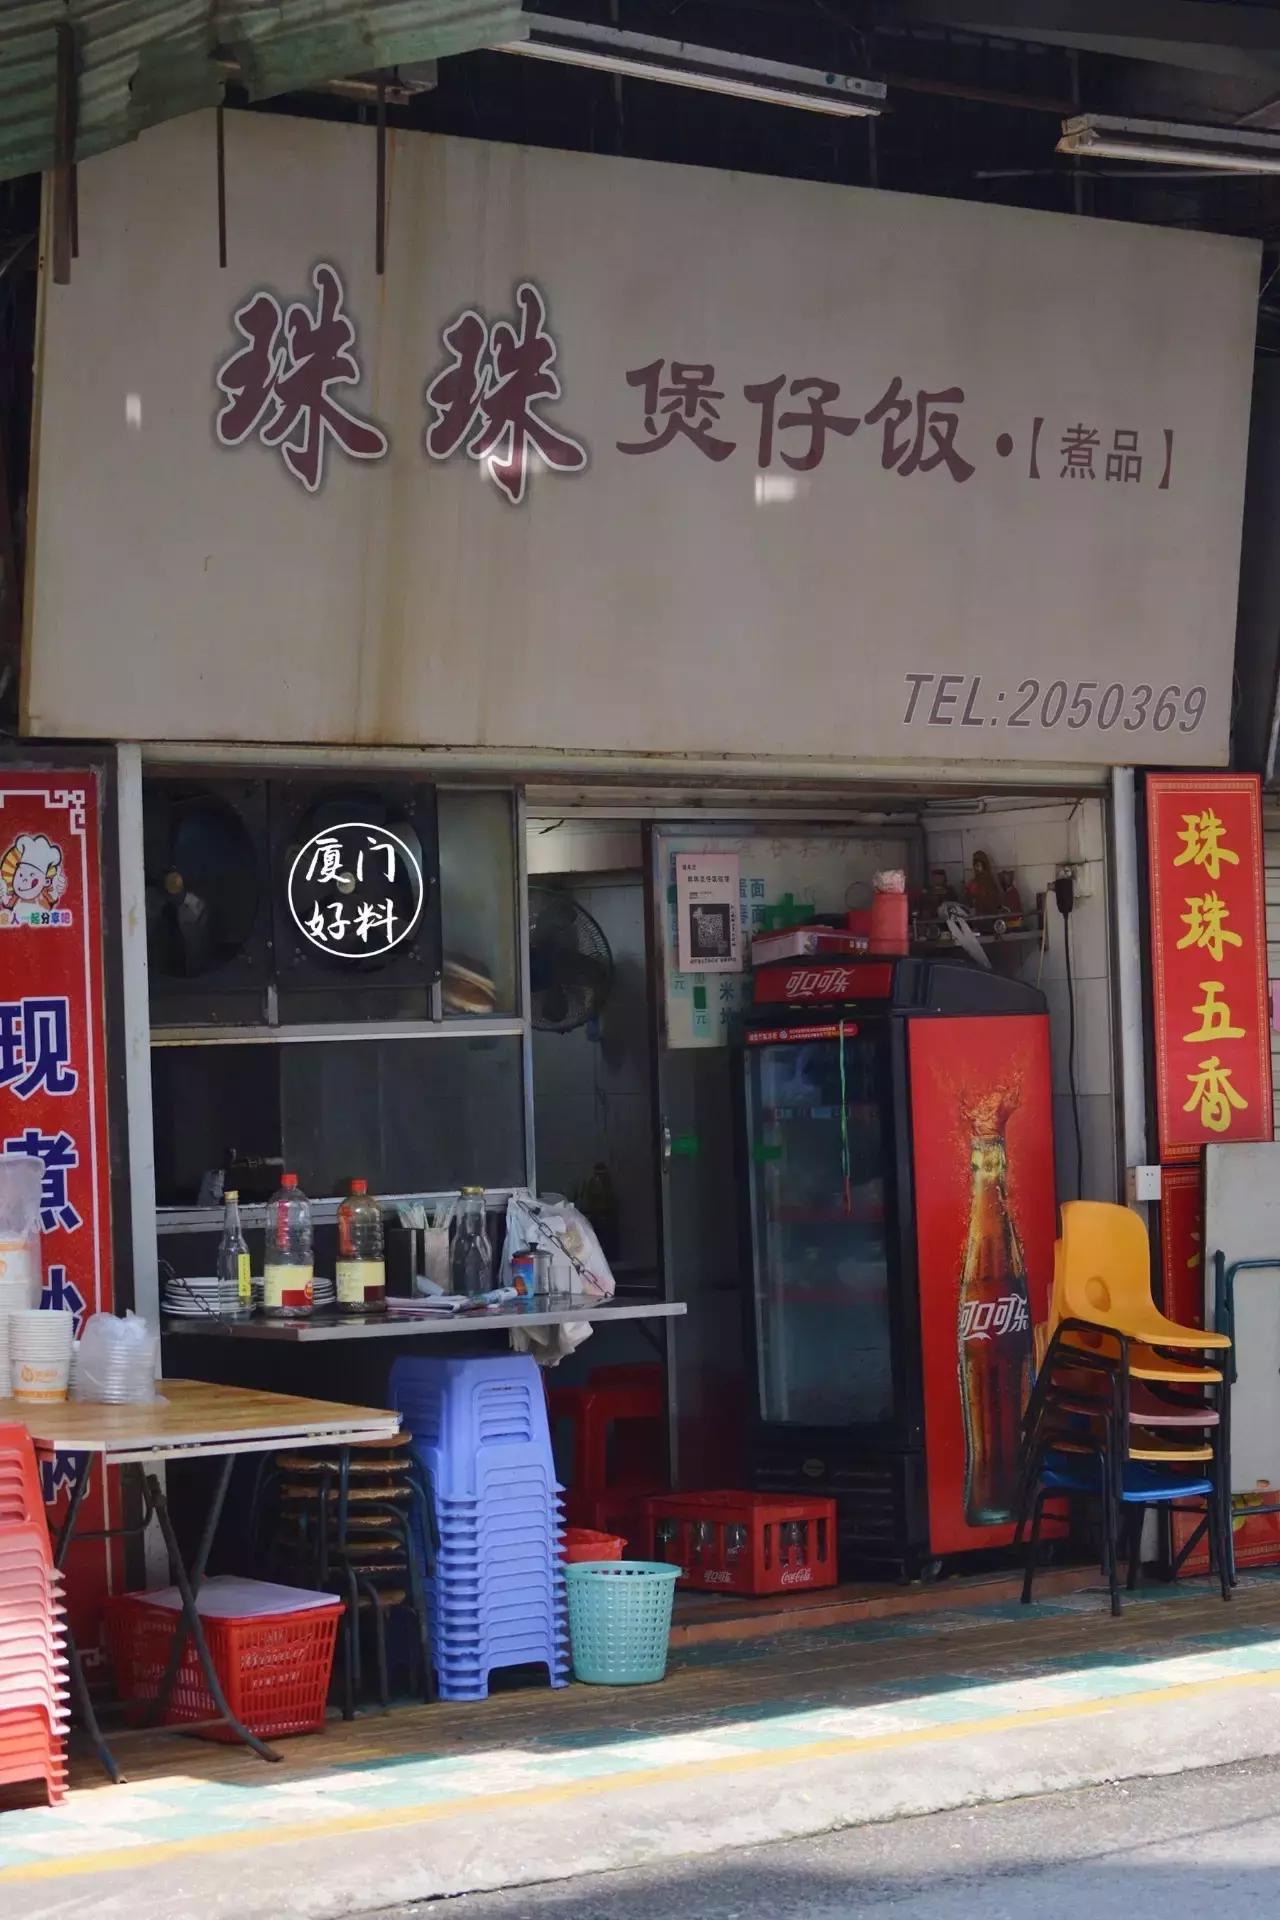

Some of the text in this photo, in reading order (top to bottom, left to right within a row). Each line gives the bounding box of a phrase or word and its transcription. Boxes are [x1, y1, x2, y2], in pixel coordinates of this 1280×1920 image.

[902, 672, 1207, 732] TEL:2050369
[785, 967, 854, 997] 可口可乐
[1173, 808, 1249, 1132] 珠珠五香
[960, 1293, 1029, 1341] 可口可乐
[781, 1568, 812, 1585] Coca-Cola
